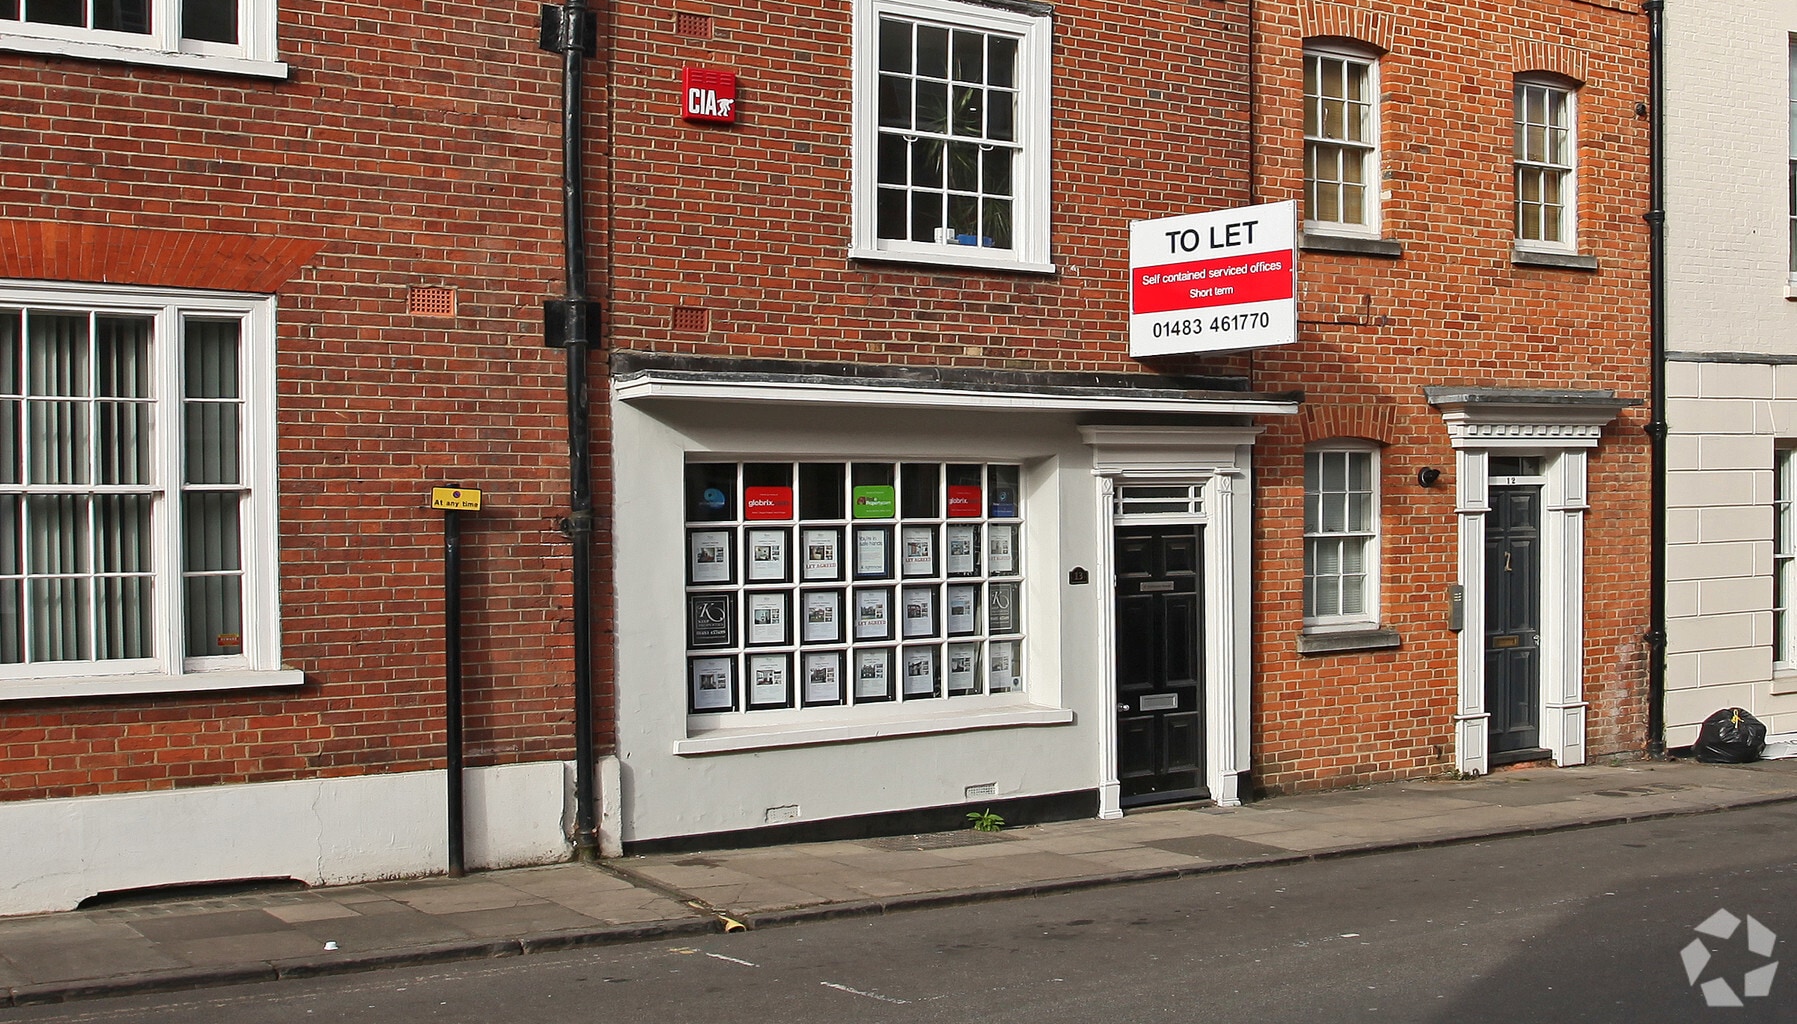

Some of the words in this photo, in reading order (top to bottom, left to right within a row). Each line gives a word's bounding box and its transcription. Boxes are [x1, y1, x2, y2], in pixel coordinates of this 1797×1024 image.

[688, 87, 717, 116] CIA
[1165, 229, 1200, 254] TO
[1210, 220, 1259, 249] LET
[1142, 272, 1161, 286] Self
[1162, 268, 1207, 283] contained
[1208, 263, 1248, 278] serviced
[1249, 260, 1282, 273] offices
[1189, 288, 1213, 298] Short
[1214, 286, 1234, 296] term
[1153, 318, 1202, 338] 01483
[1209, 311, 1269, 333] 461770
[446, 500, 459, 508] any
